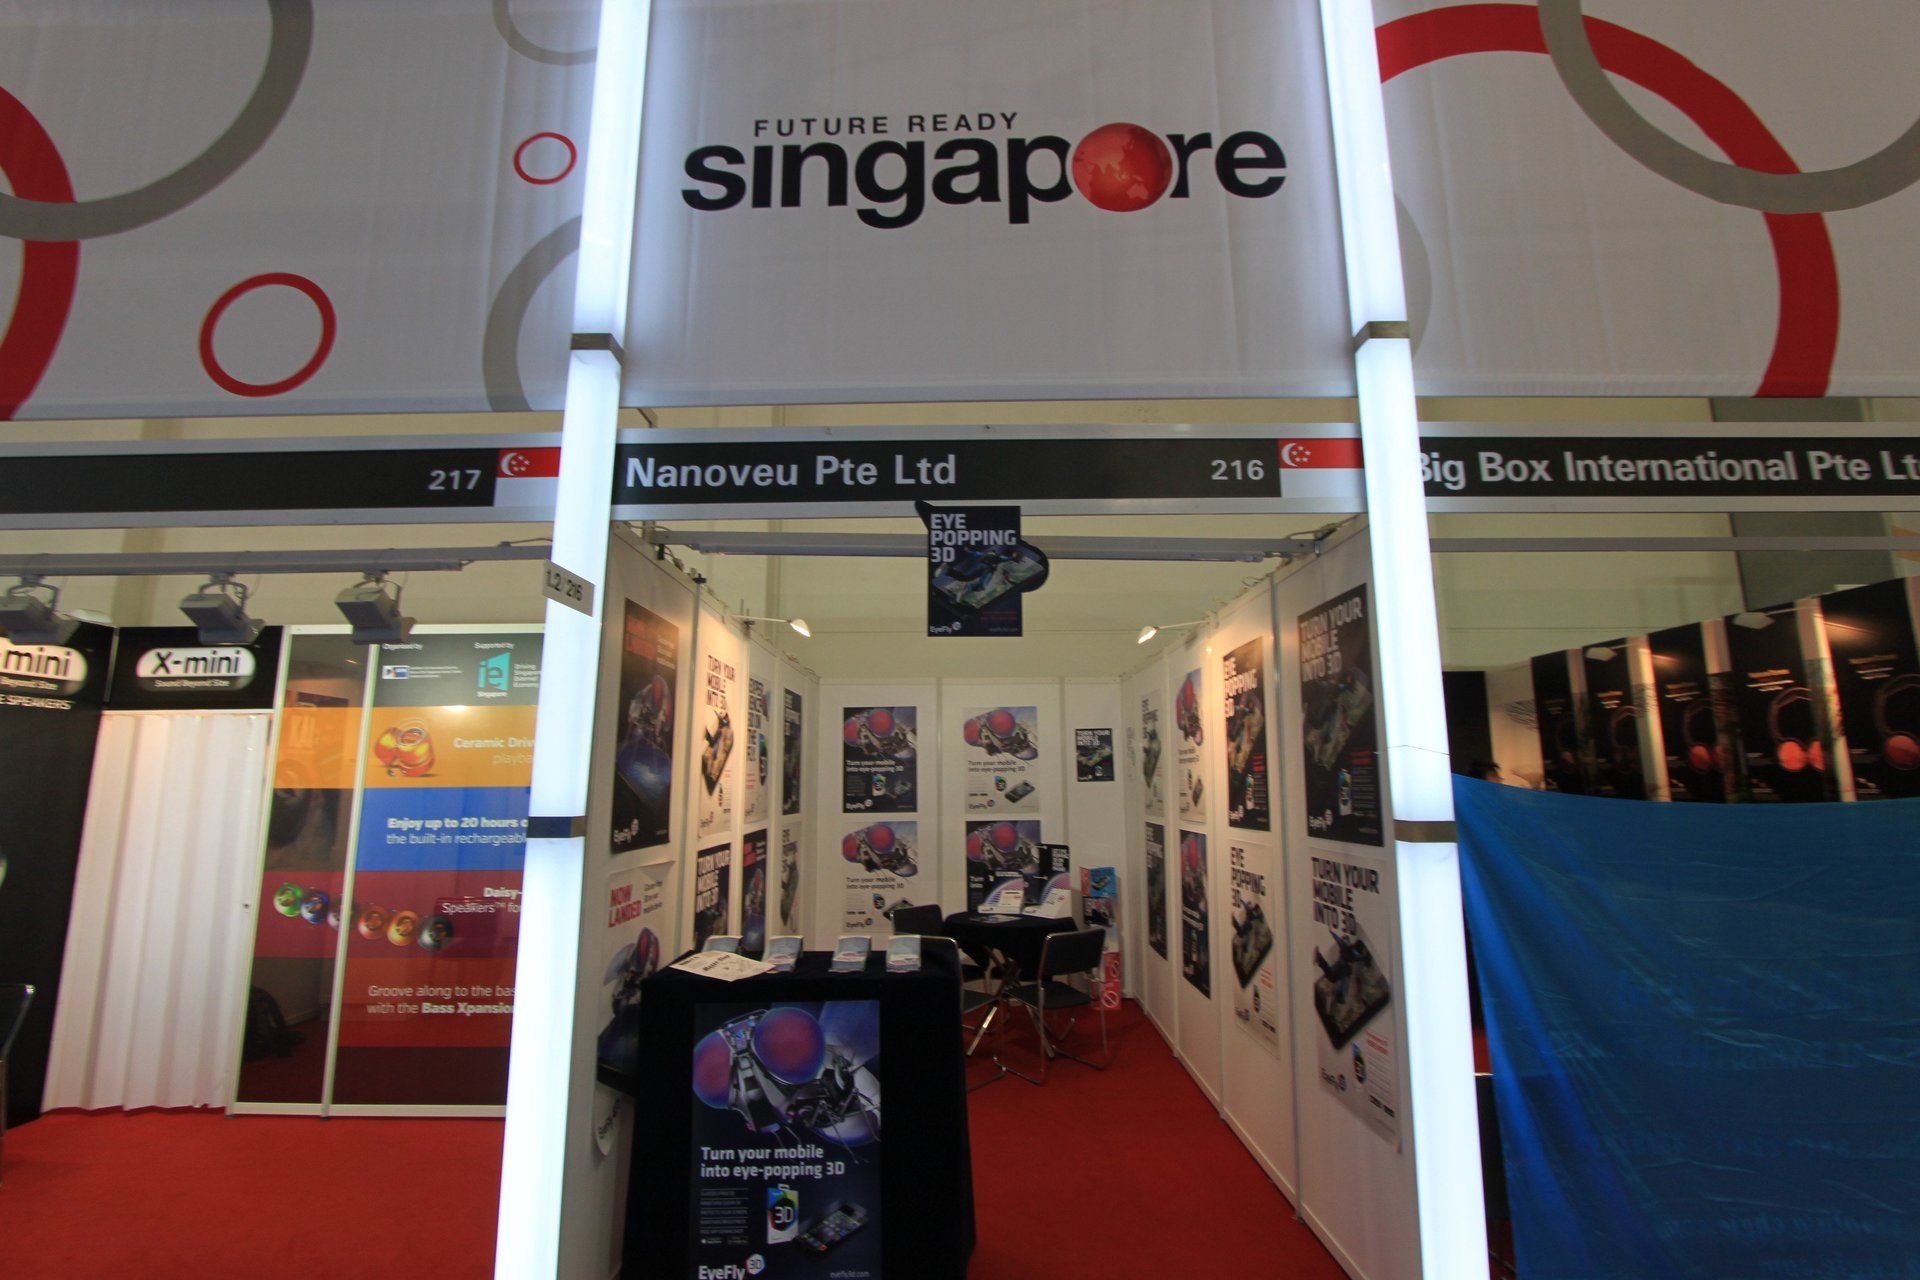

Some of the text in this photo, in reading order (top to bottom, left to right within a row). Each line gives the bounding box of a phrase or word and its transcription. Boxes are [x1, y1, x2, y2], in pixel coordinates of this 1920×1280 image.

[754, 112, 1019, 138] FUTURE READY
[625, 454, 956, 488] Nanoveu Pte Ltd
[1211, 459, 1264, 481] 216
[1480, 451, 1552, 482] Box
[1566, 450, 1797, 482] International
[1806, 450, 1872, 480] Pte
[1880, 450, 1920, 480] Lt
[428, 469, 482, 491] 217
[930, 513, 966, 529] EYE
[930, 530, 1017, 546] POPPING
[930, 547, 955, 562] 3D
[152, 649, 241, 674] X-mini
[453, 736, 504, 748] Ceramic
[387, 817, 423, 830] Enjoy
[425, 818, 442, 830] up
[444, 818, 458, 828] to
[460, 818, 478, 828] 20
[480, 816, 519, 828] hours
[386, 833, 407, 844] the
[409, 833, 451, 844] built-in
[1311, 856, 1380, 895] TURN YOUR
[1313, 879, 1353, 912] MOBILE
[1313, 900, 1357, 936] INTO 3D
[368, 985, 413, 997] Groove
[416, 985, 452, 999] along
[454, 986, 468, 997] to
[471, 985, 492, 997] the
[367, 1002, 395, 1014] with
[397, 1002, 418, 1014] the
[421, 1002, 454, 1014] Bass
[701, 1145, 824, 1163] Turn your mobile
[700, 1161, 845, 1179] into eye-popping 3D
[774, 1206, 794, 1224] 3D
